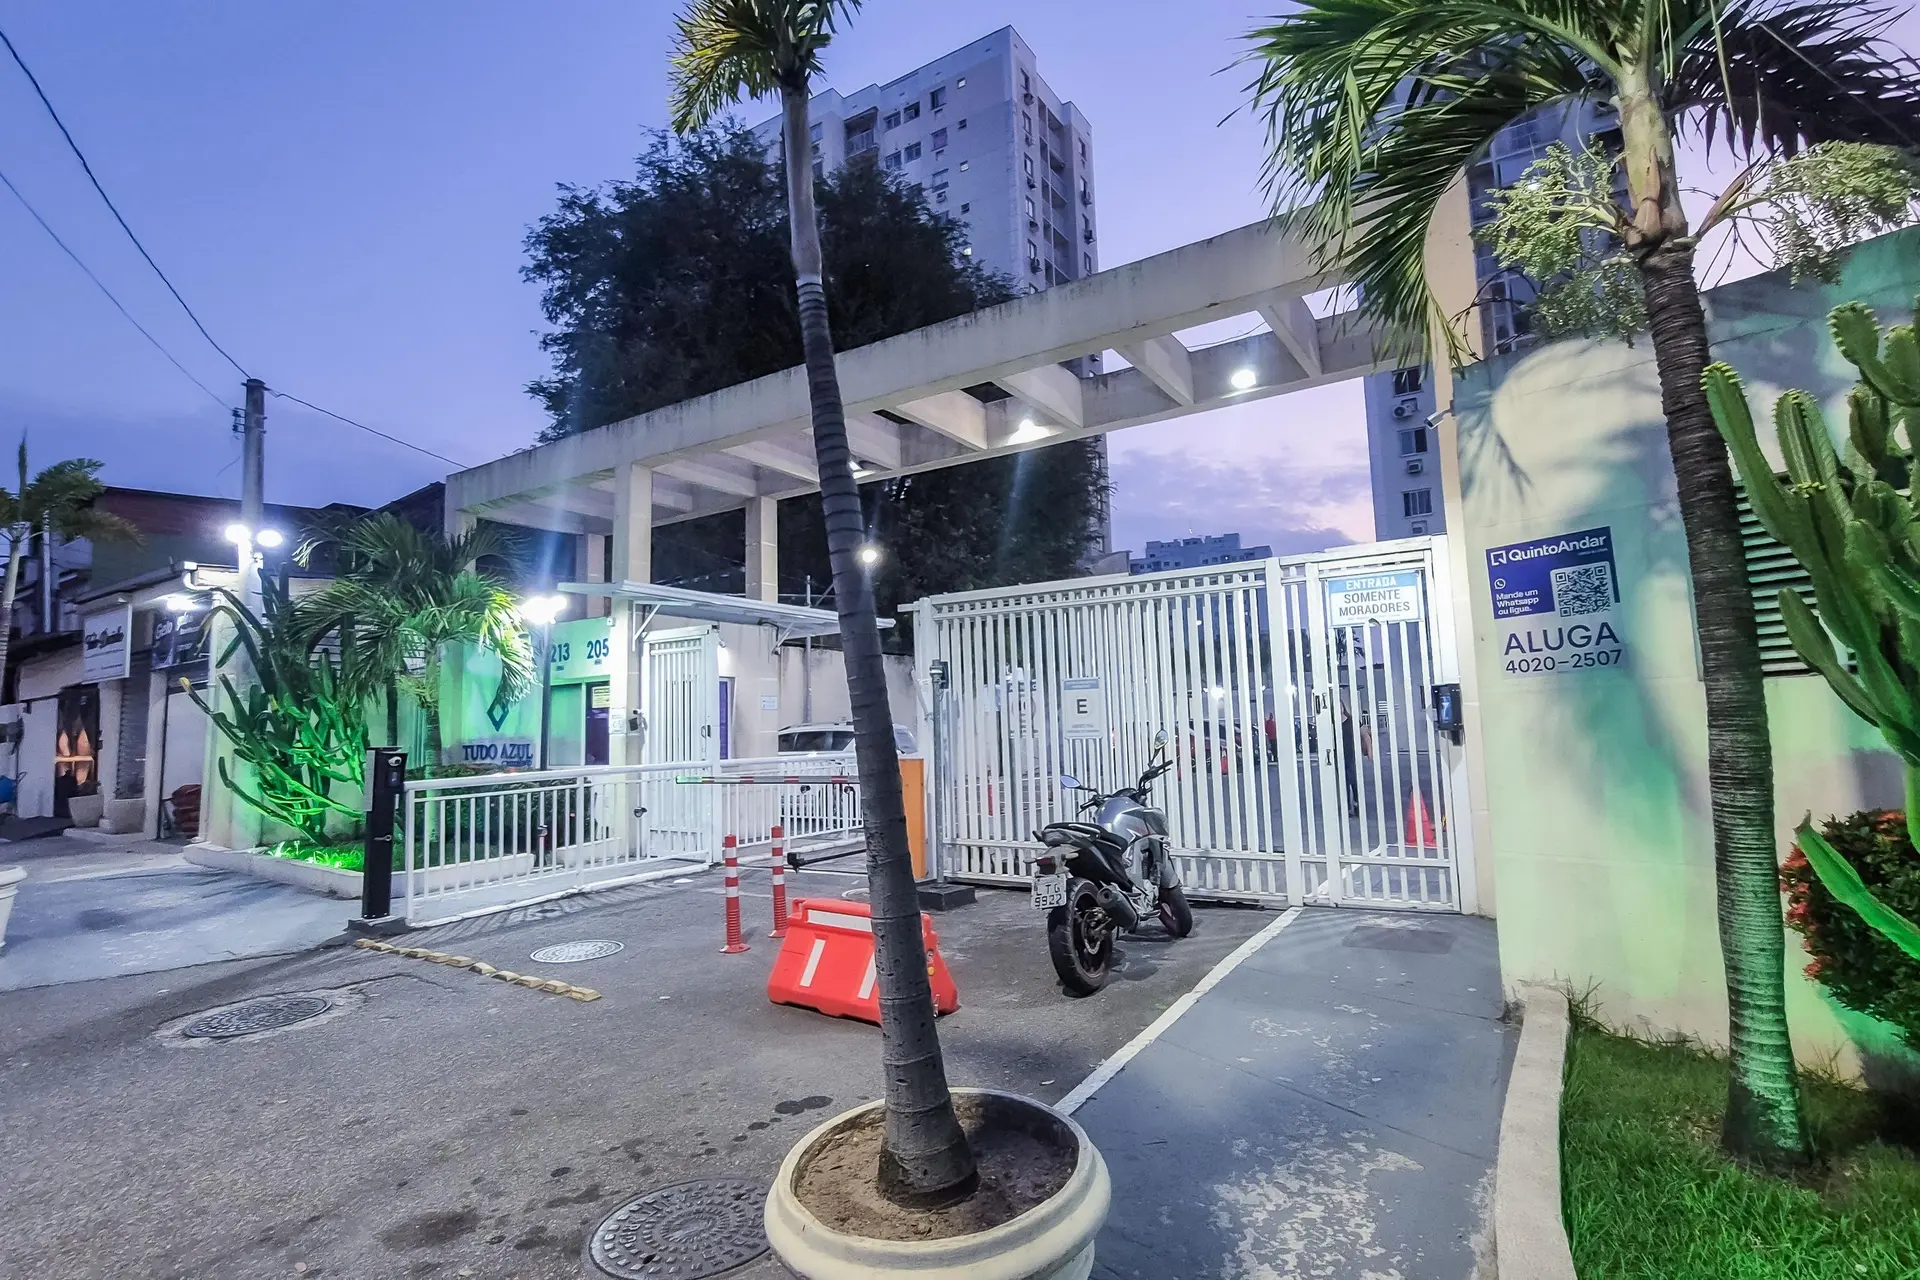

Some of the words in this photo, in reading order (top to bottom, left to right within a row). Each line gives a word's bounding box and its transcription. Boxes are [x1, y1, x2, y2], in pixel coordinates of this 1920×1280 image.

[1508, 536, 1607, 561] QuintoAndar
[1345, 576, 1397, 590] ENTRADA
[1343, 589, 1401, 604] SOMENTE
[1496, 591, 1524, 600] Mande
[1524, 589, 1538, 597] um
[1497, 597, 1539, 608] Whatsapp
[1339, 601, 1411, 617] MORADORES
[1503, 621, 1620, 656] ALUGA
[550, 642, 571, 662] 213
[586, 637, 610, 659] 205
[1505, 649, 1622, 674] 4020-2507
[1076, 699, 1088, 714] E
[462, 743, 498, 761] TUDO
[500, 742, 534, 760] AZUL
